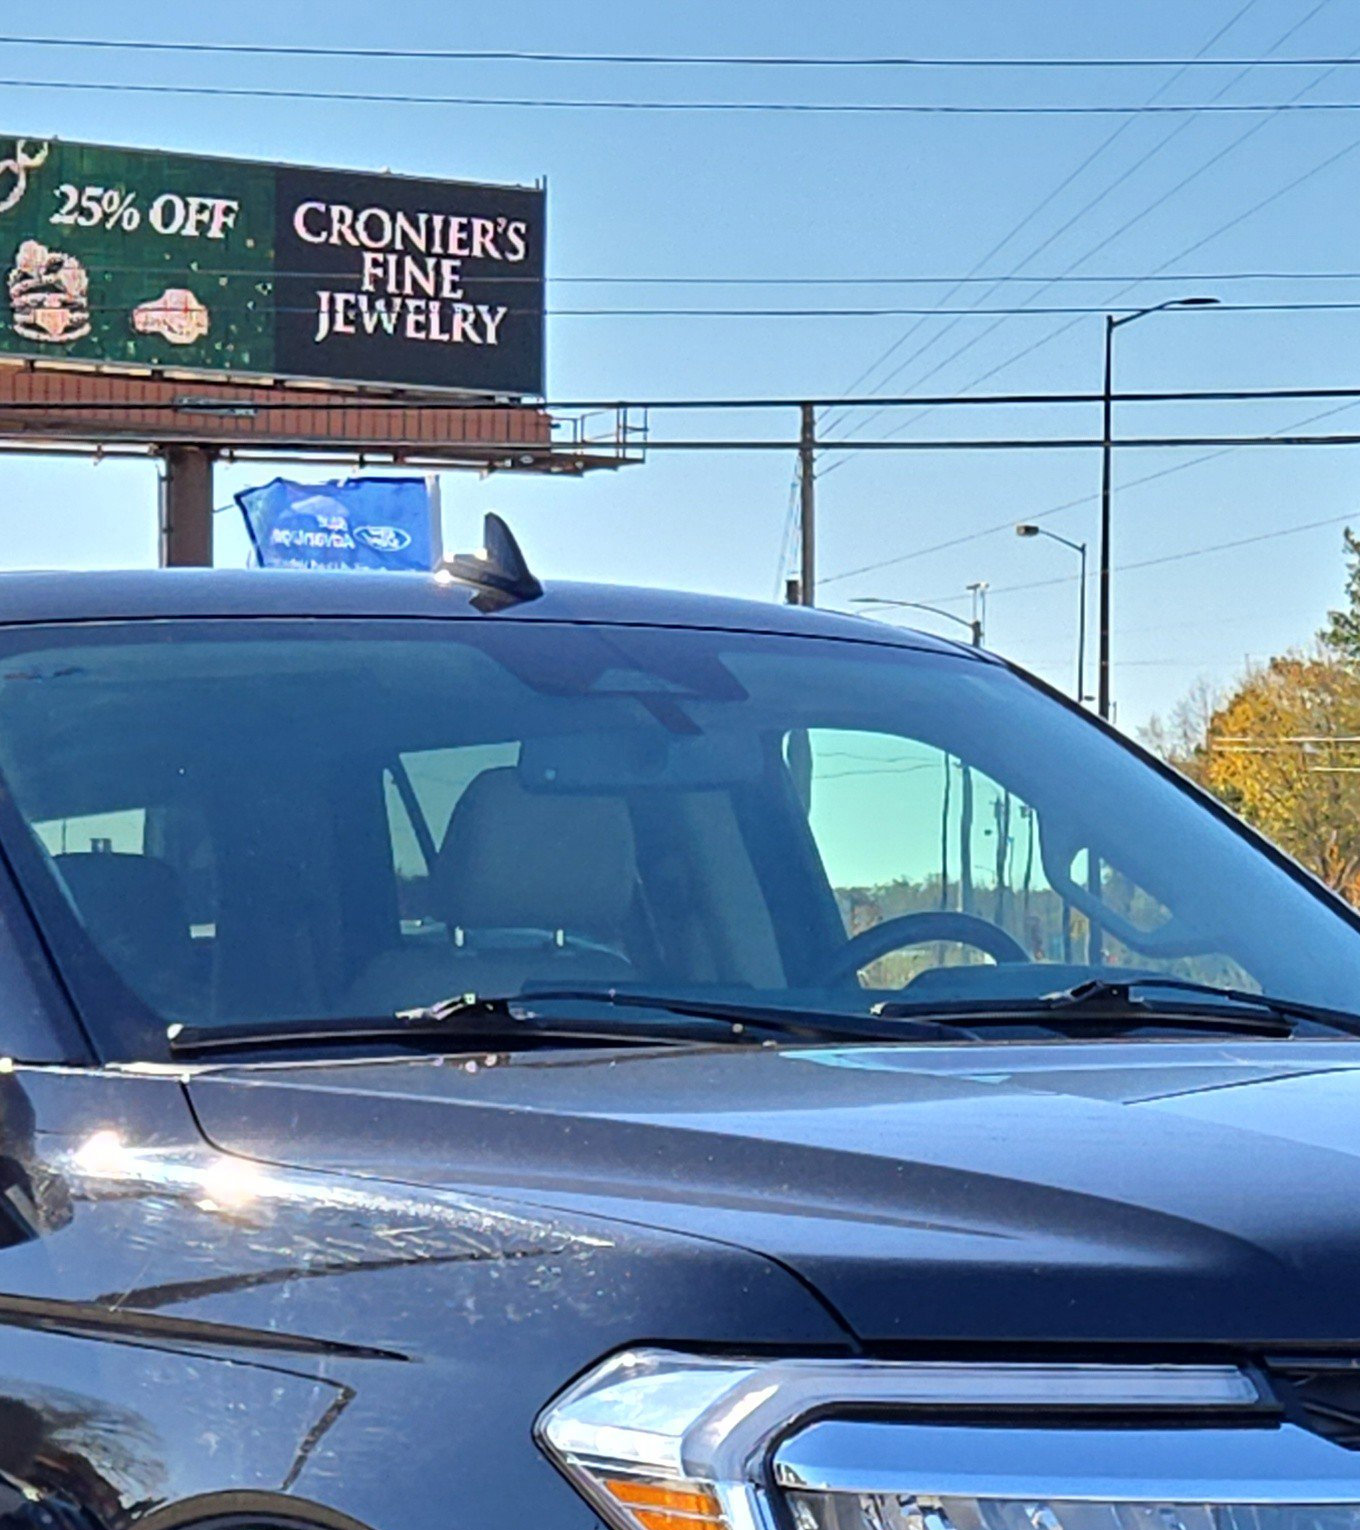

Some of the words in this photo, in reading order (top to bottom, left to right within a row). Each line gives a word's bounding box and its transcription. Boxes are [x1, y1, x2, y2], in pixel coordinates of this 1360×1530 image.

[49, 183, 141, 232] 25%
[149, 192, 239, 239] OFF
[292, 201, 527, 262] CRONIER'S
[360, 251, 463, 299] FINE
[314, 290, 508, 345] JEWELRY
